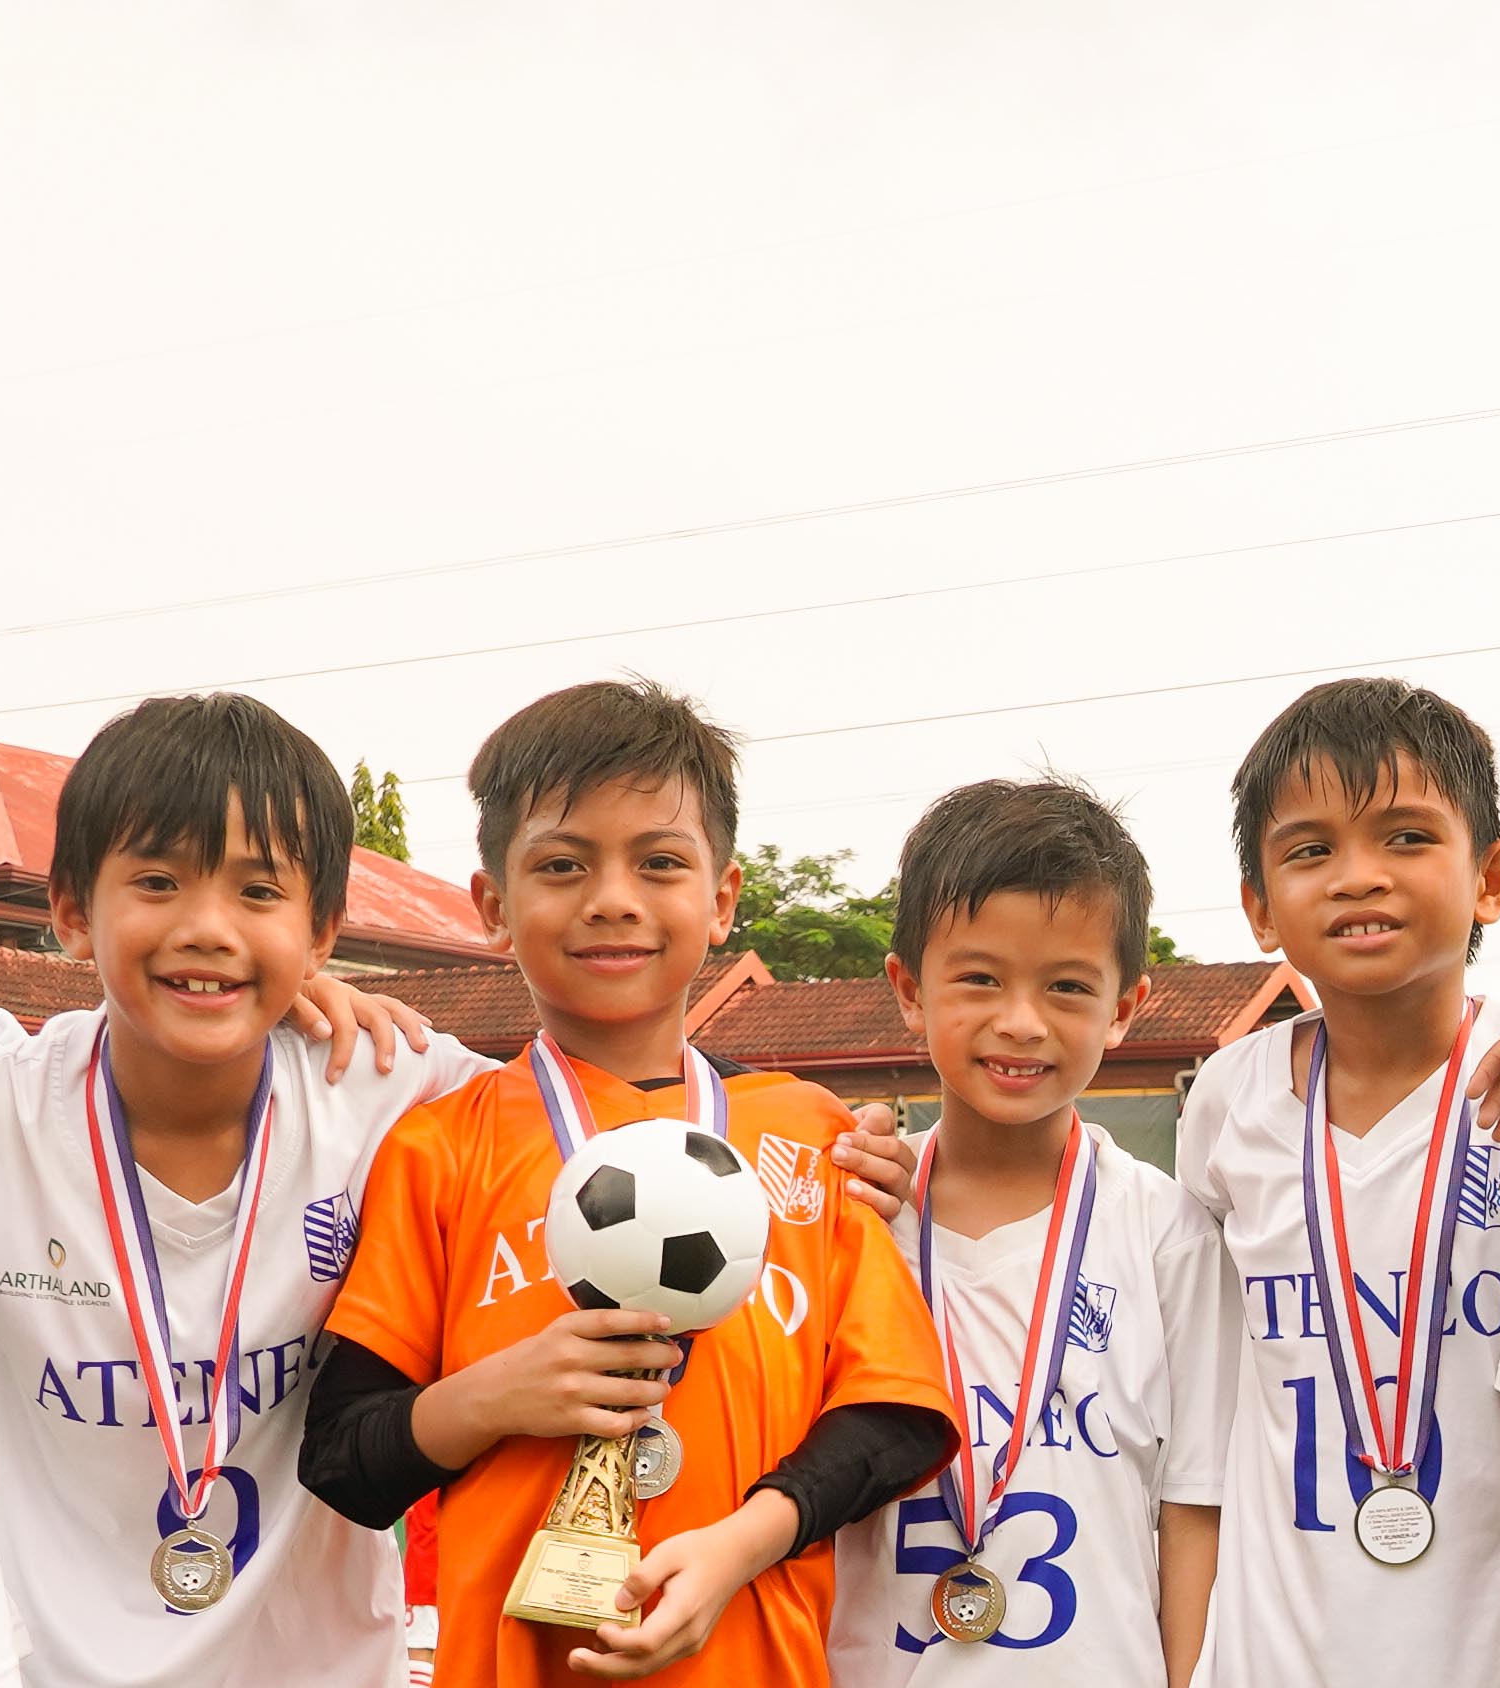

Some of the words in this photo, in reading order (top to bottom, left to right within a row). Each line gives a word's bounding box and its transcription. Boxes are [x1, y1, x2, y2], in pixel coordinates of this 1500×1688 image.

[35, 1322, 330, 1429] ATENE
[969, 1382, 1120, 1458] NEO
[156, 1465, 261, 1617] 9
[894, 1490, 1079, 1655] 53
